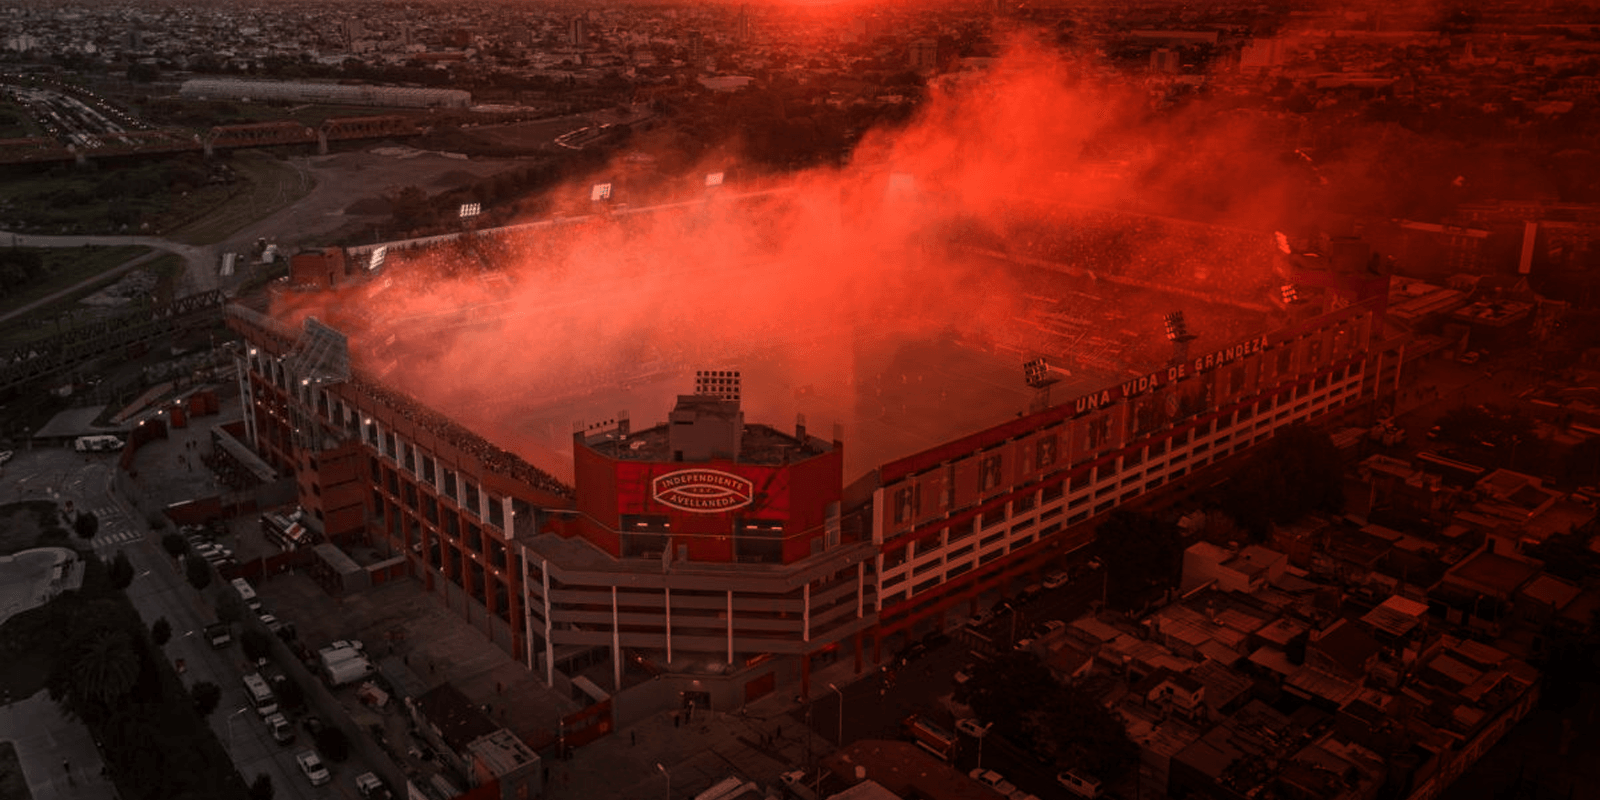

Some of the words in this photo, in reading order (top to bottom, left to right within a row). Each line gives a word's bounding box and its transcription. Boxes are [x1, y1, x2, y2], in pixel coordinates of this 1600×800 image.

[1076, 390, 1110, 413] UNA
[1122, 374, 1158, 397] VIDA
[1168, 364, 1185, 381] DE
[1195, 334, 1269, 371] GRANDEZA
[662, 475, 744, 490] INDEPENDIENTE
[670, 494, 736, 507] AVELLANEDA
